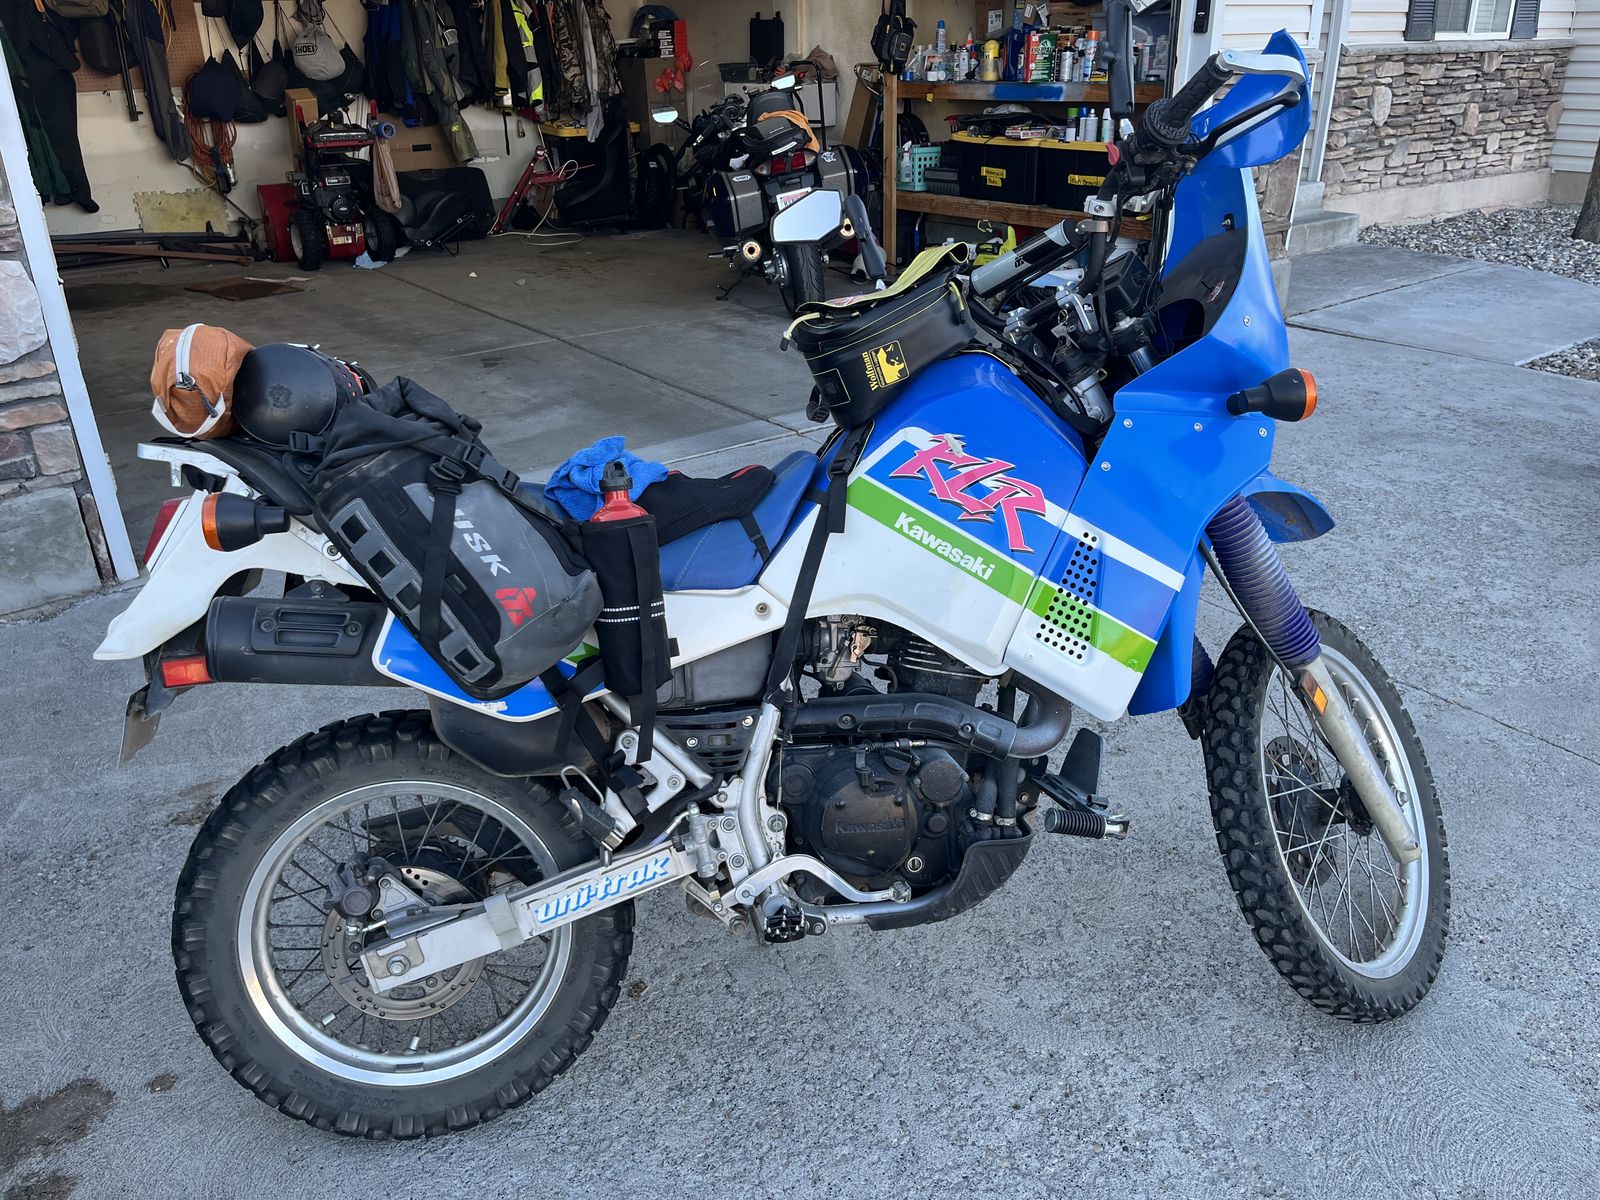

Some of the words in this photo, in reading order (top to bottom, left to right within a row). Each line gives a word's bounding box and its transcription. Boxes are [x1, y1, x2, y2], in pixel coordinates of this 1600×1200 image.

[862, 351, 879, 391] Wolfman
[888, 433, 1047, 553] KLR
[894, 511, 996, 581] Kawasaki
[537, 856, 670, 923] uni-trak
